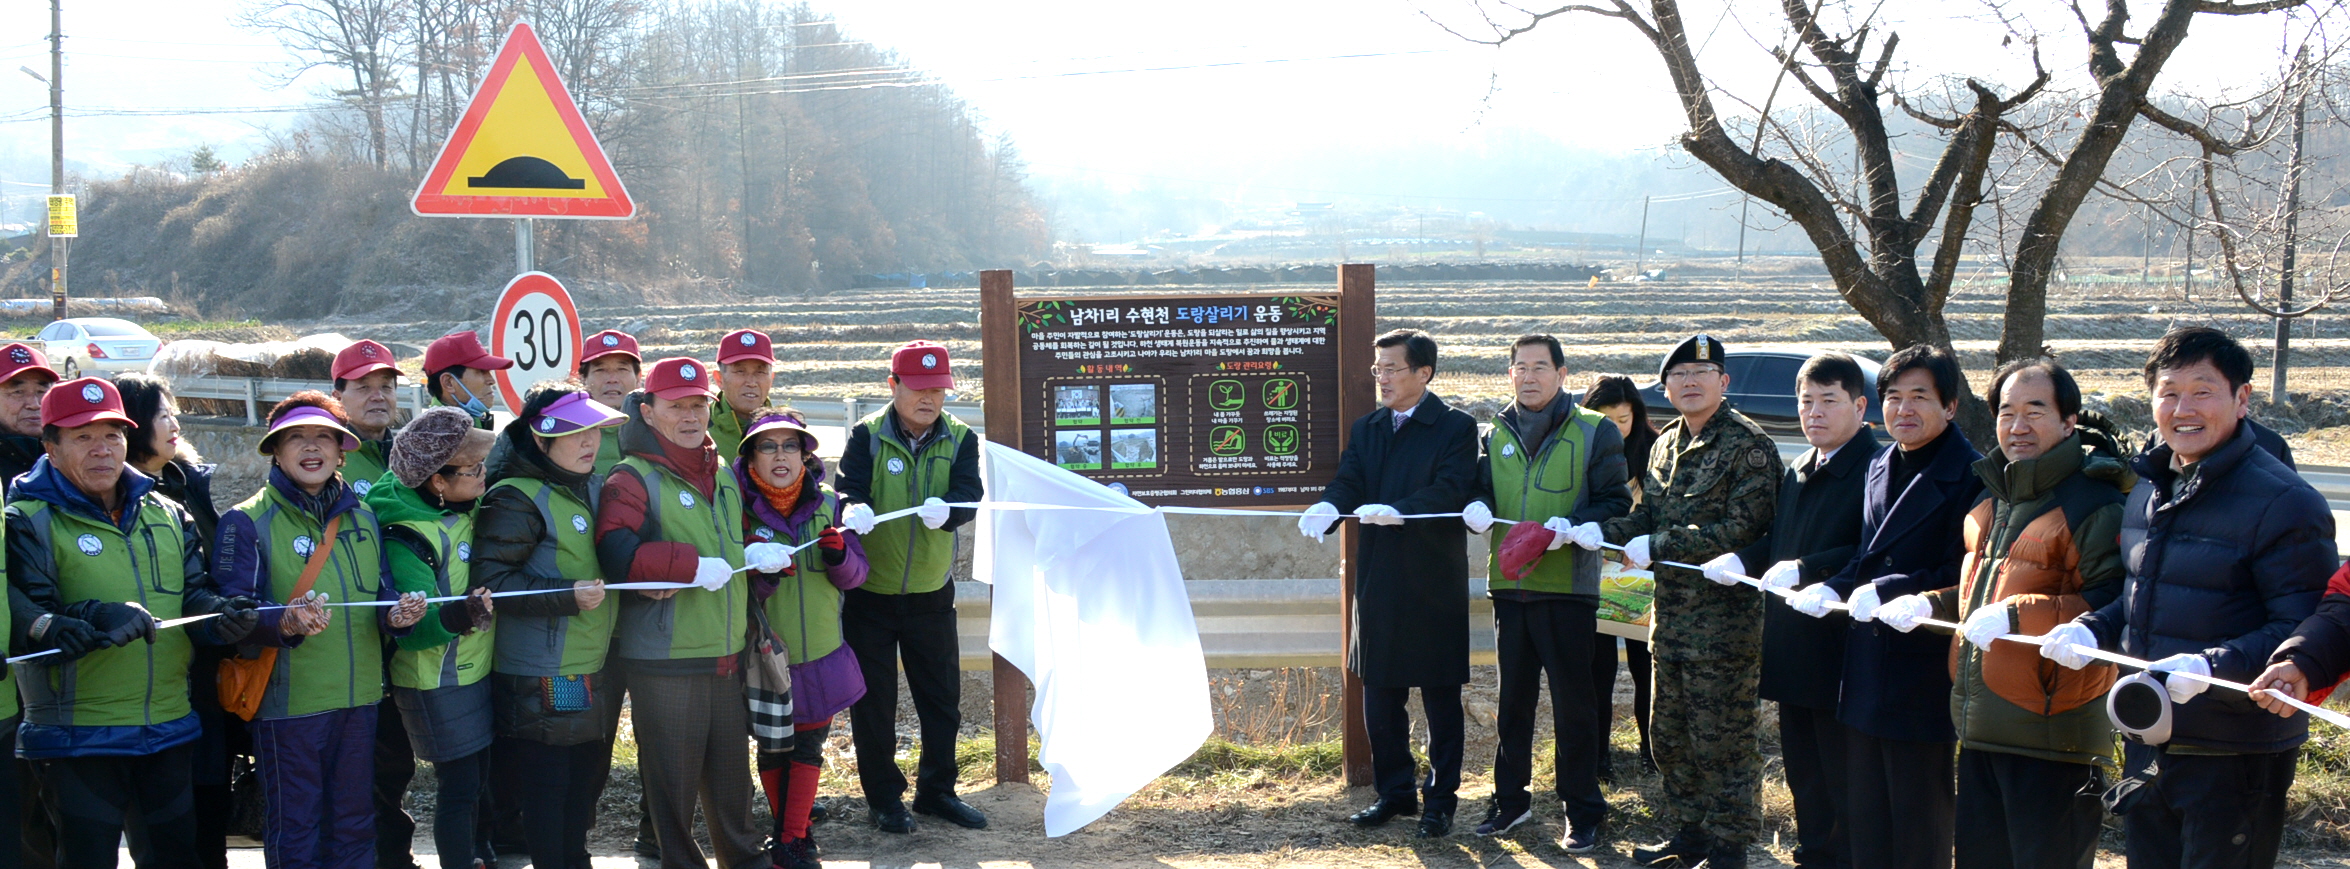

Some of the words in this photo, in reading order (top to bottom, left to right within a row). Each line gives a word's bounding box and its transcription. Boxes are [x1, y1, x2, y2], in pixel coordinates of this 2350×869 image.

[1070, 308, 1119, 326] 남차1리
[1126, 307, 1170, 324] 수현천
[1176, 305, 1248, 324] 도랑살리기
[1253, 305, 1283, 322] 운동
[514, 307, 562, 371] 30
[1031, 332, 1045, 340] 마을
[1046, 332, 1066, 340] 주민이
[1068, 331, 1100, 340] 자발적으로
[1102, 330, 1128, 338] 참여하는
[1164, 330, 1185, 338] 운동은,
[1187, 329, 1207, 338] 도랑을
[1208, 329, 1234, 337] 되살리는
[1236, 328, 1249, 336] 일로
[1250, 328, 1263, 336] 삶의
[1265, 328, 1278, 336] 질을
[1280, 328, 1311, 336] 향상시키고
[1032, 342, 1058, 350] 공동체를
[1060, 342, 1086, 350] 회복하는
[1088, 341, 1101, 349] 길이
[1111, 340, 1138, 348] 것입니다.
[1140, 340, 1153, 348] 하천
[1154, 340, 1174, 348] 생태계
[1176, 338, 1208, 347] 복원운동을
[1210, 338, 1242, 346] 지속적으로
[1243, 338, 1268, 346] 추진하여
[1285, 337, 1311, 345] 생태계에
[1312, 337, 1325, 345] 대한
[1055, 351, 1080, 360] 주민들의
[1082, 351, 1102, 359] 관심을
[1104, 350, 1136, 358] 고조시키고
[1138, 350, 1157, 358] 나아가
[1180, 349, 1202, 357] 남차1리
[1204, 348, 1218, 356] 마을
[1219, 348, 1245, 356] 도랑에서
[1247, 348, 1260, 356] 꿈과
[1261, 348, 1280, 356] 희망을
[1226, 362, 1241, 370] 도랑
[1243, 361, 1272, 370] 관리요령
[219, 523, 236, 572] JEANS
